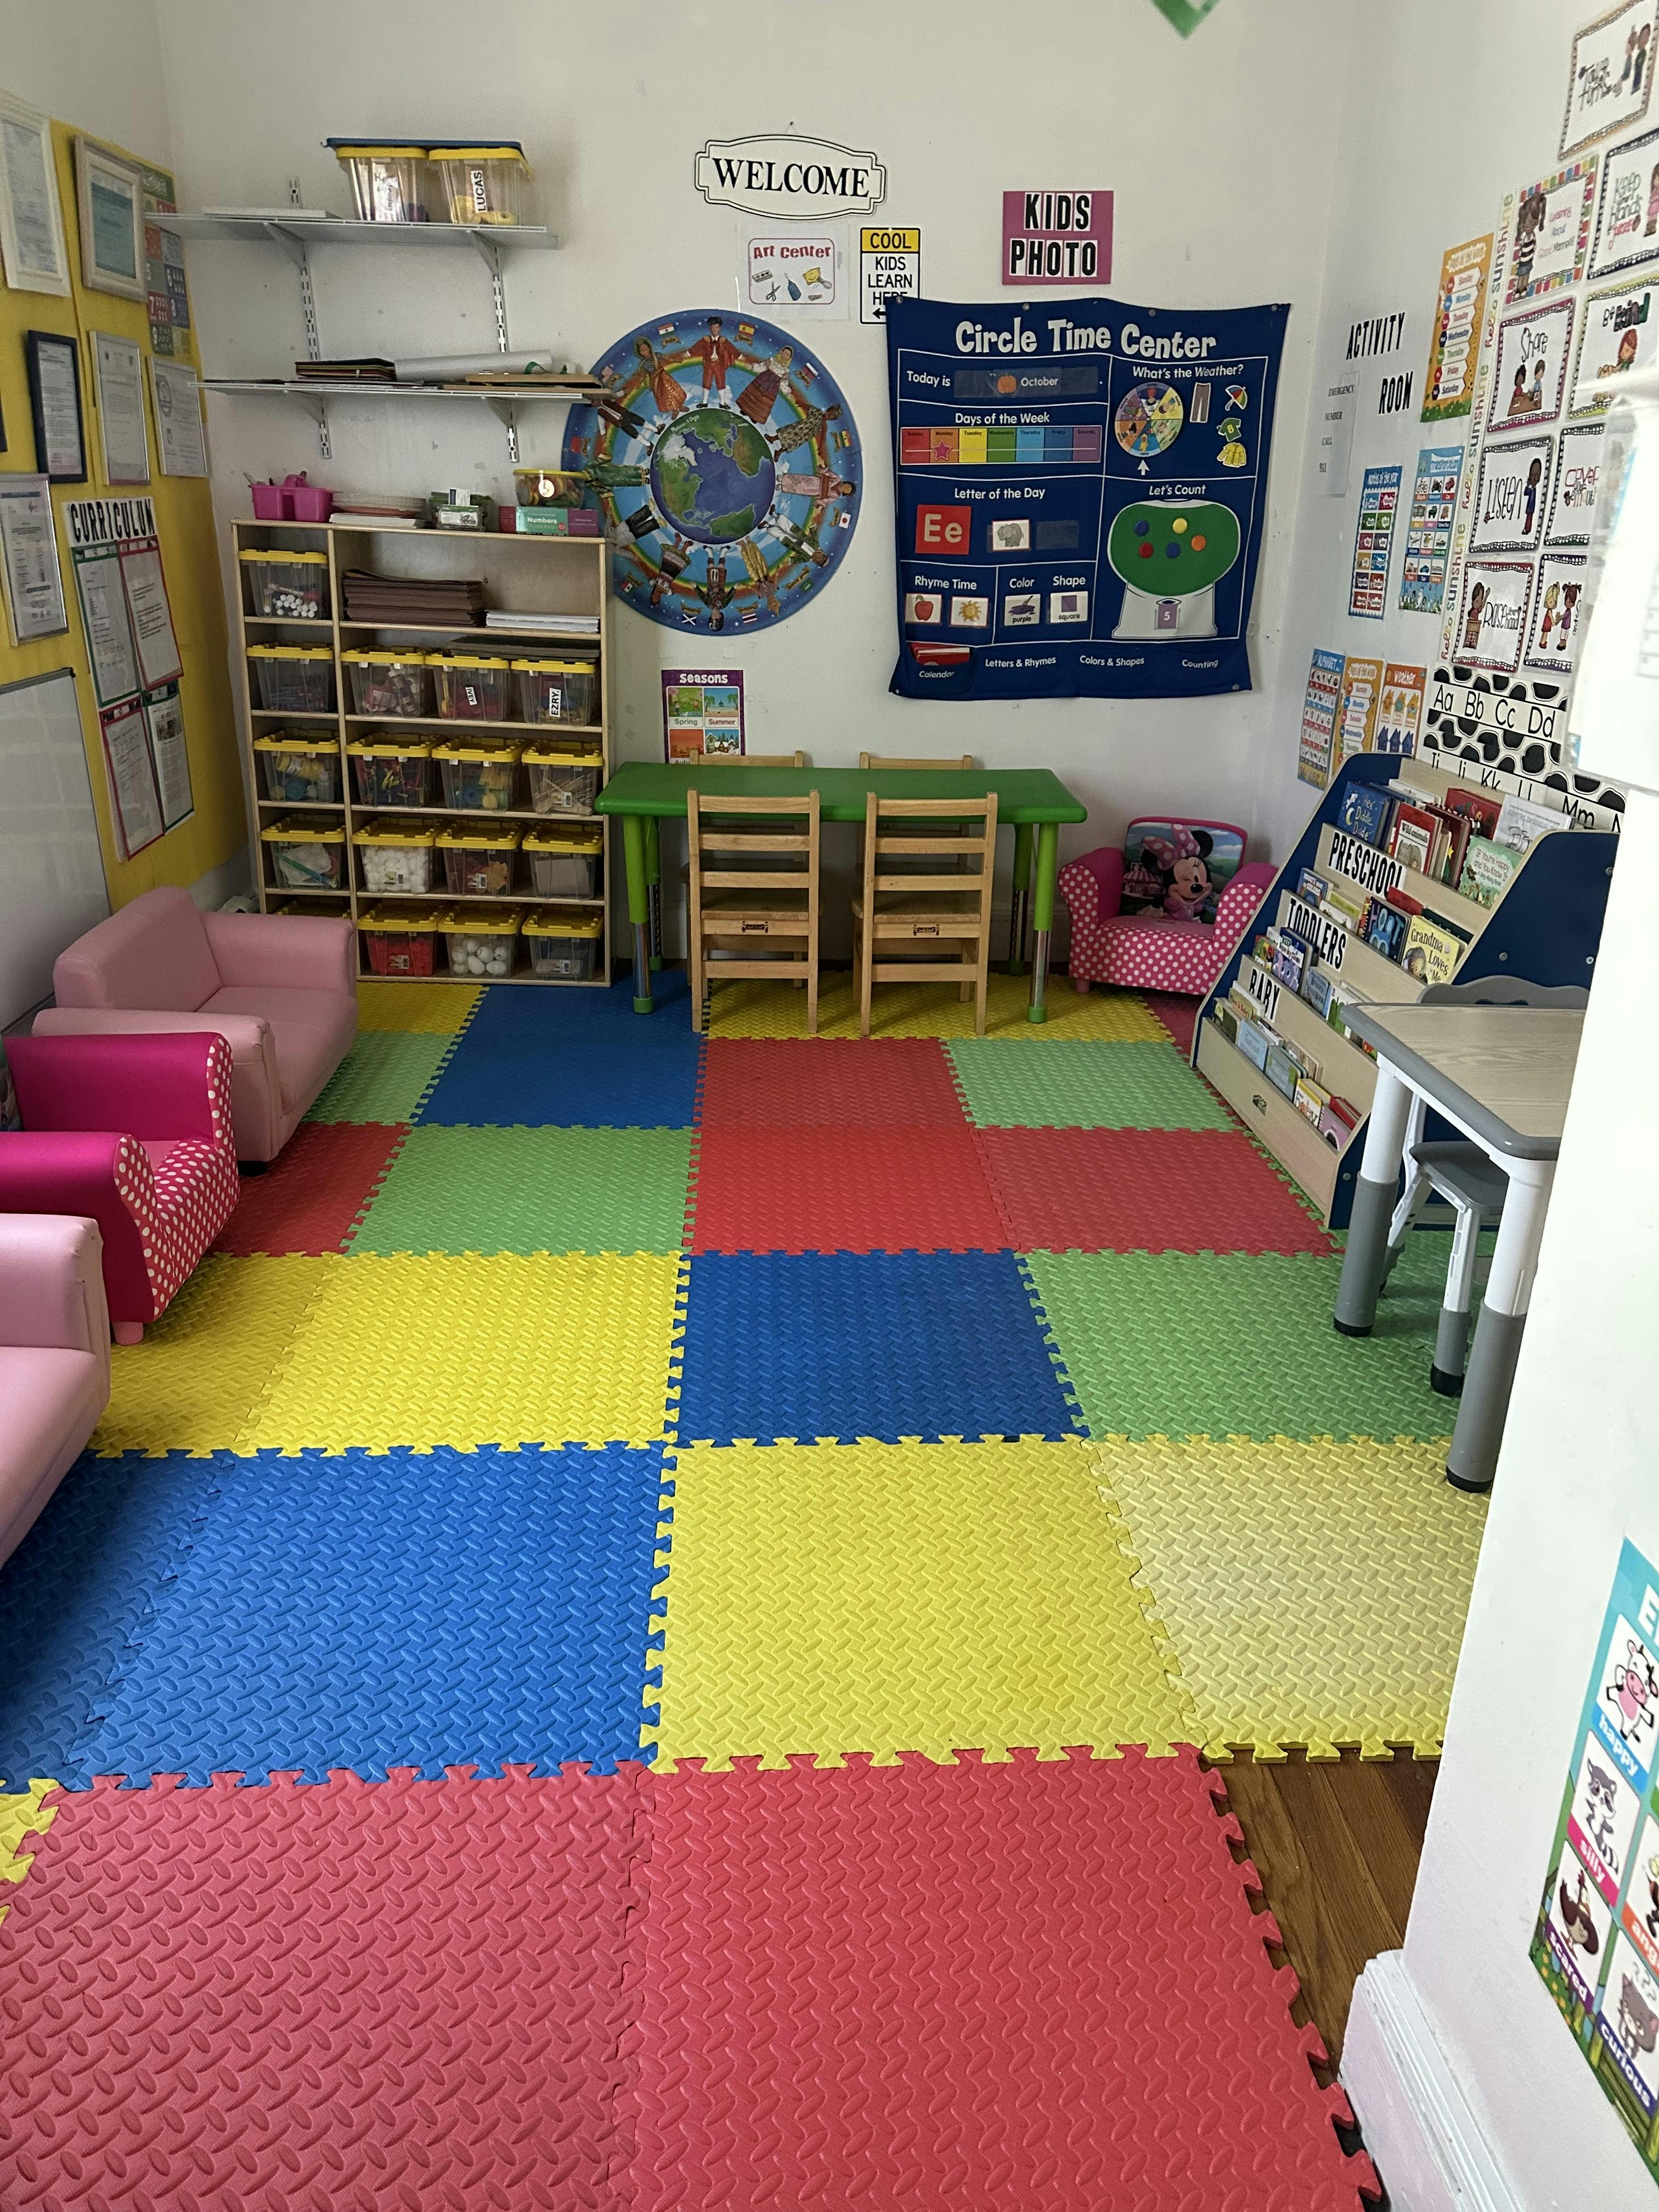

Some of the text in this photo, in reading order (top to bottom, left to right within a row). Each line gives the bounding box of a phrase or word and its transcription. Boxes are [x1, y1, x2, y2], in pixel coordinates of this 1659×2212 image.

[712, 157, 871, 198] WELCOME
[474, 172, 486, 211] LUCAS
[1025, 193, 1091, 230] KIDS
[870, 233, 911, 249] COOL
[1492, 194, 1513, 294] sunshine
[754, 246, 775, 259] Art
[1010, 240, 1097, 276] PHOTO
[876, 257, 906, 270] KIDS
[166, 268, 173, 287] 6
[868, 274, 912, 288] LEARN
[1459, 275, 1473, 286] Sunday
[149, 295, 155, 316] 7
[171, 298, 177, 317] 8
[1453, 311, 1469, 322] Tuesday
[153, 326, 158, 345] 9
[955, 317, 1217, 358] Circle Time Center
[1346, 312, 1406, 360] ACTIVITY
[1448, 328, 1470, 341] Wednesday
[1447, 348, 1464, 359] Thursday
[907, 370, 950, 387] Today is
[1132, 364, 1243, 379] What's the Weather?
[1447, 365, 1459, 375] Friday
[1020, 377, 1059, 387] October
[1328, 385, 1355, 396] EMERGENCY
[1442, 384, 1459, 394] Saturday
[1378, 371, 1414, 414] ROOM
[955, 412, 1049, 426] Days of the Week
[1469, 364, 1488, 458] sunshine
[1322, 437, 1333, 445] CALL
[955, 487, 1046, 499] Letter of the Day
[1149, 484, 1206, 495] Let's Count
[70, 499, 156, 543] CURRICULUM
[924, 514, 963, 543] Ee
[915, 575, 977, 590] Rhyme Time
[1009, 577, 1034, 588] Color
[1053, 575, 1086, 588] Shape
[1441, 523, 1465, 659] hello sunshine
[1013, 615, 1031, 624] purple
[1164, 611, 1170, 620] 5
[985, 659, 1014, 668] Letters
[1025, 657, 1057, 668] Rhymes
[1080, 655, 1144, 668] Colors & Shapes
[1182, 659, 1218, 668] Counting
[919, 670, 955, 678] Calendar
[467, 688, 475, 703] IVEY
[1434, 684, 1555, 738] Aa Bb Cc Dd
[1364, 794, 1373, 810] Hey
[1562, 795, 1595, 827] Mm
[1402, 822, 1428, 843] Wild animals
[1328, 832, 1403, 899] PRESCHOOL
[1474, 860, 1482, 870] and
[1483, 862, 1491, 873] You
[1491, 866, 1502, 878] Know
[1288, 900, 1347, 969] TODDLERS
[1411, 929, 1443, 953] Grandma
[1429, 950, 1449, 975] Loves
[1431, 970, 1441, 981] Me
[1250, 968, 1280, 1019] BABY
[1599, 1713, 1639, 1776] happy
[1580, 1840, 1606, 1883] silly
[1550, 1931, 1587, 2002] scared
[1601, 2023, 1650, 2108] curious
